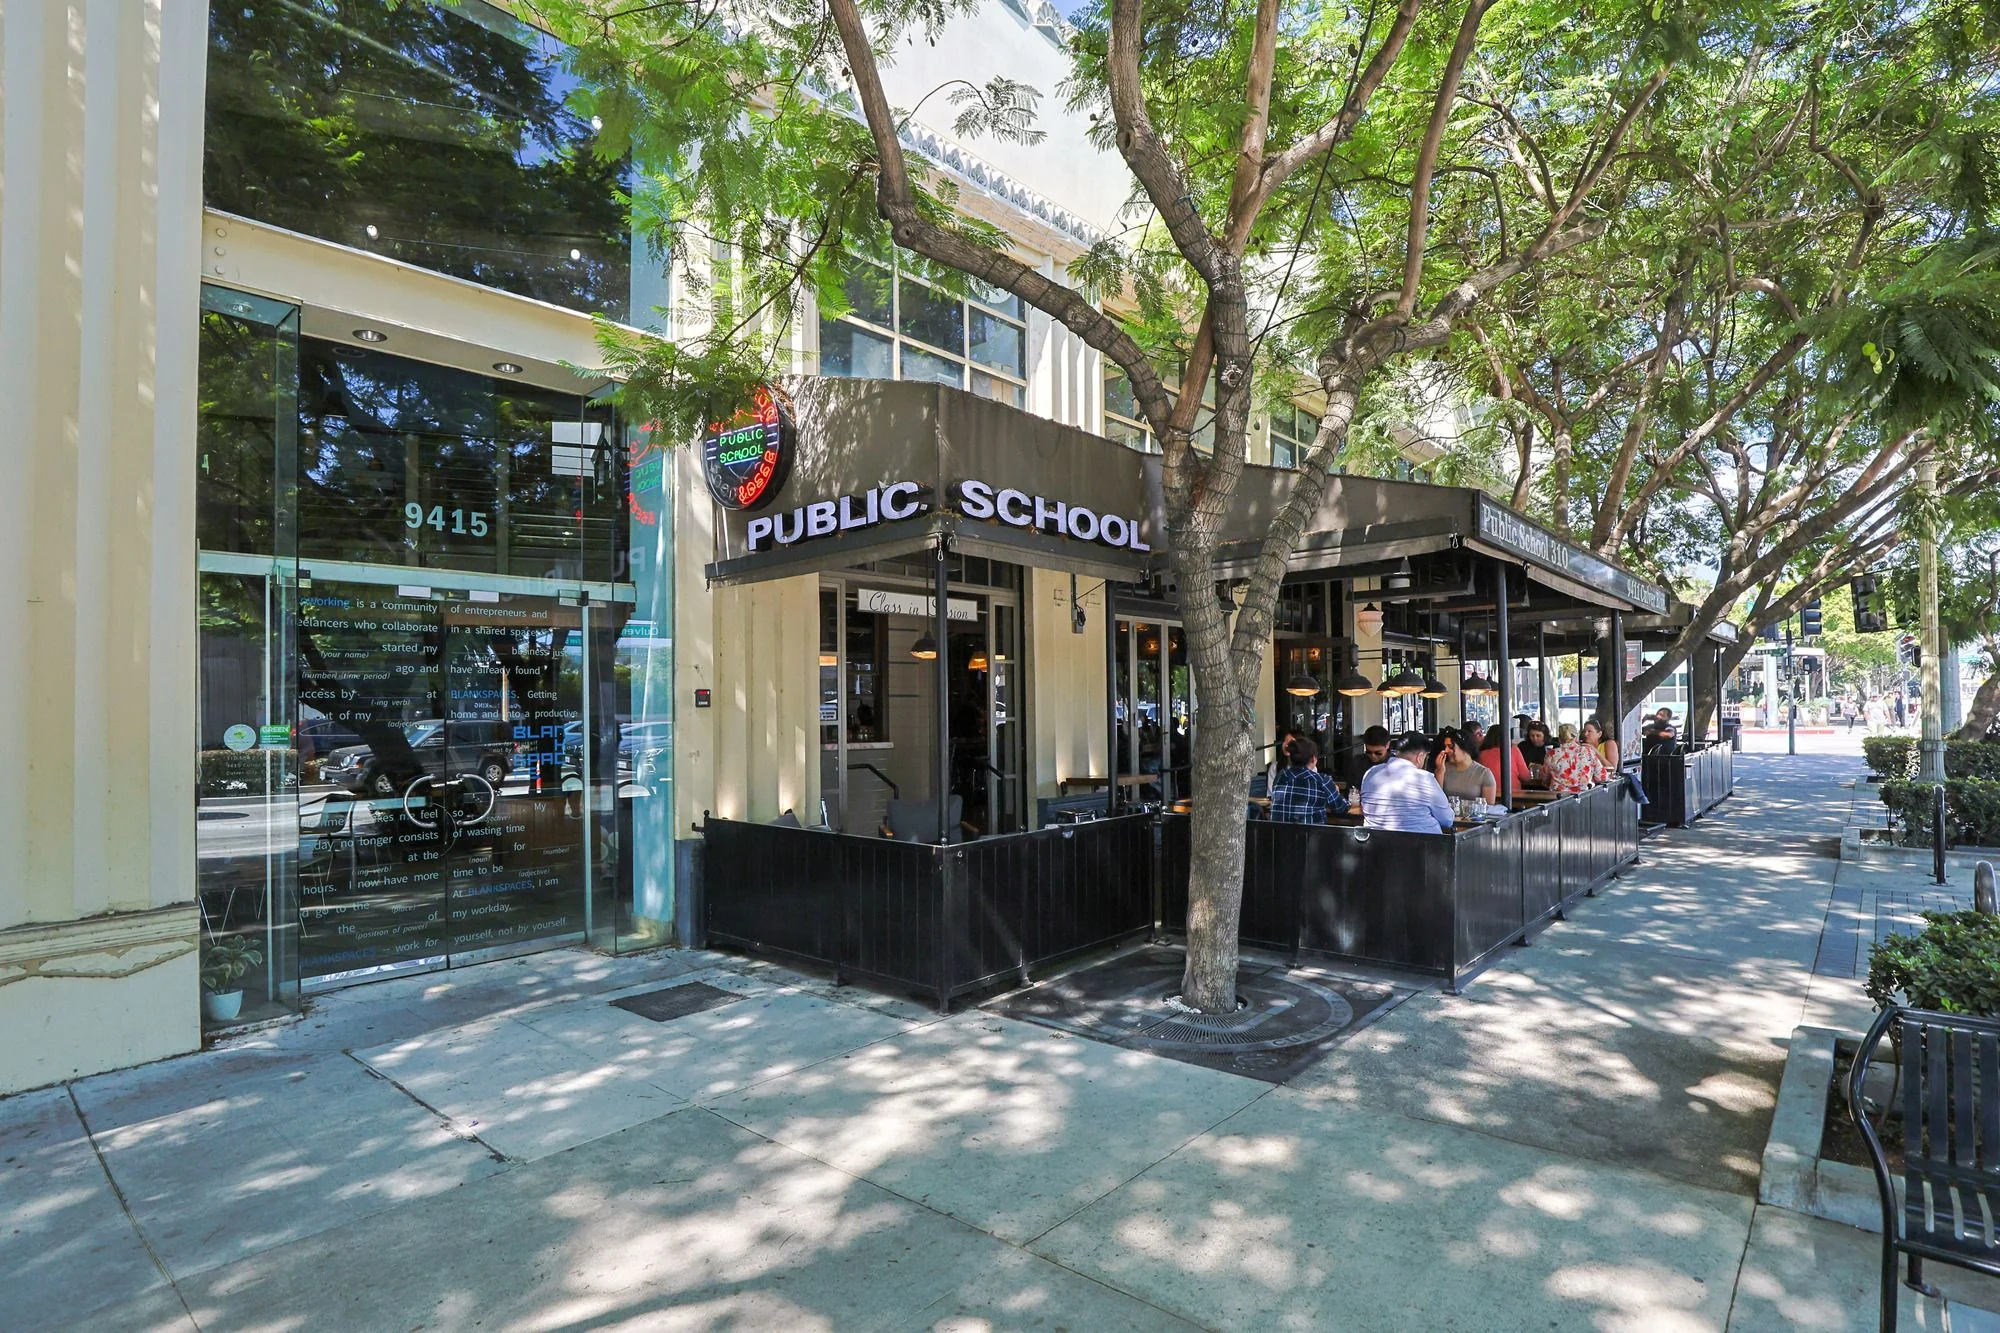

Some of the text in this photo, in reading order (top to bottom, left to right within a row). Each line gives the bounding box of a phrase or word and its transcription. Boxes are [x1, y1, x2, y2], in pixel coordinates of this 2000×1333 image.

[720, 428, 764, 446] PUBLIC
[720, 444, 764, 464] SCHOOL
[404, 502, 489, 537] 9415
[747, 479, 1151, 552] PUBLIC SCHOOL
[1481, 502, 1569, 570] Public School 310
[356, 599, 365, 609] is
[370, 601, 376, 609] a
[382, 600, 438, 614] community
[450, 605, 461, 614] of
[464, 607, 527, 618] entrepreneurs
[531, 610, 548, 619] and
[869, 591, 902, 613] Class
[908, 602, 920, 616] in
[354, 620, 377, 630] who
[382, 621, 438, 632] collaborate
[450, 624, 460, 633] in
[475, 625, 506, 636] shared
[382, 643, 418, 653] started
[423, 645, 438, 655] my
[395, 664, 415, 675] ago
[420, 663, 439, 673] and
[450, 665, 473, 674] have
[515, 665, 541, 675] found
[298, 690, 336, 700] uccess
[426, 690, 437, 699] at
[527, 690, 558, 701] Getting
[339, 710, 351, 720] of
[355, 712, 372, 722] my
[450, 710, 478, 719] home
[481, 709, 499, 718] and
[504, 710, 521, 718] nto
[534, 709, 578, 720] productive
[420, 809, 438, 819] feel
[452, 809, 464, 818] so
[534, 803, 547, 812] My
[340, 839, 354, 848] no
[360, 835, 393, 847] longer
[398, 831, 439, 843] consists
[452, 828, 463, 839] of
[467, 825, 502, 837] wasting
[505, 823, 526, 833] time
[407, 842, 526, 862] at the for
[303, 883, 337, 896] hours.
[357, 879, 381, 889] now
[383, 875, 409, 886] have
[413, 872, 439, 881] more
[452, 867, 474, 879] time
[477, 865, 488, 875] to
[492, 864, 504, 874] be
[544, 877, 559, 887] am
[338, 923, 356, 936] the
[427, 910, 439, 921] of
[452, 908, 468, 920] my
[395, 940, 420, 953] work
[425, 937, 440, 948] for
[498, 926, 513, 937] not
[517, 923, 529, 934] by
